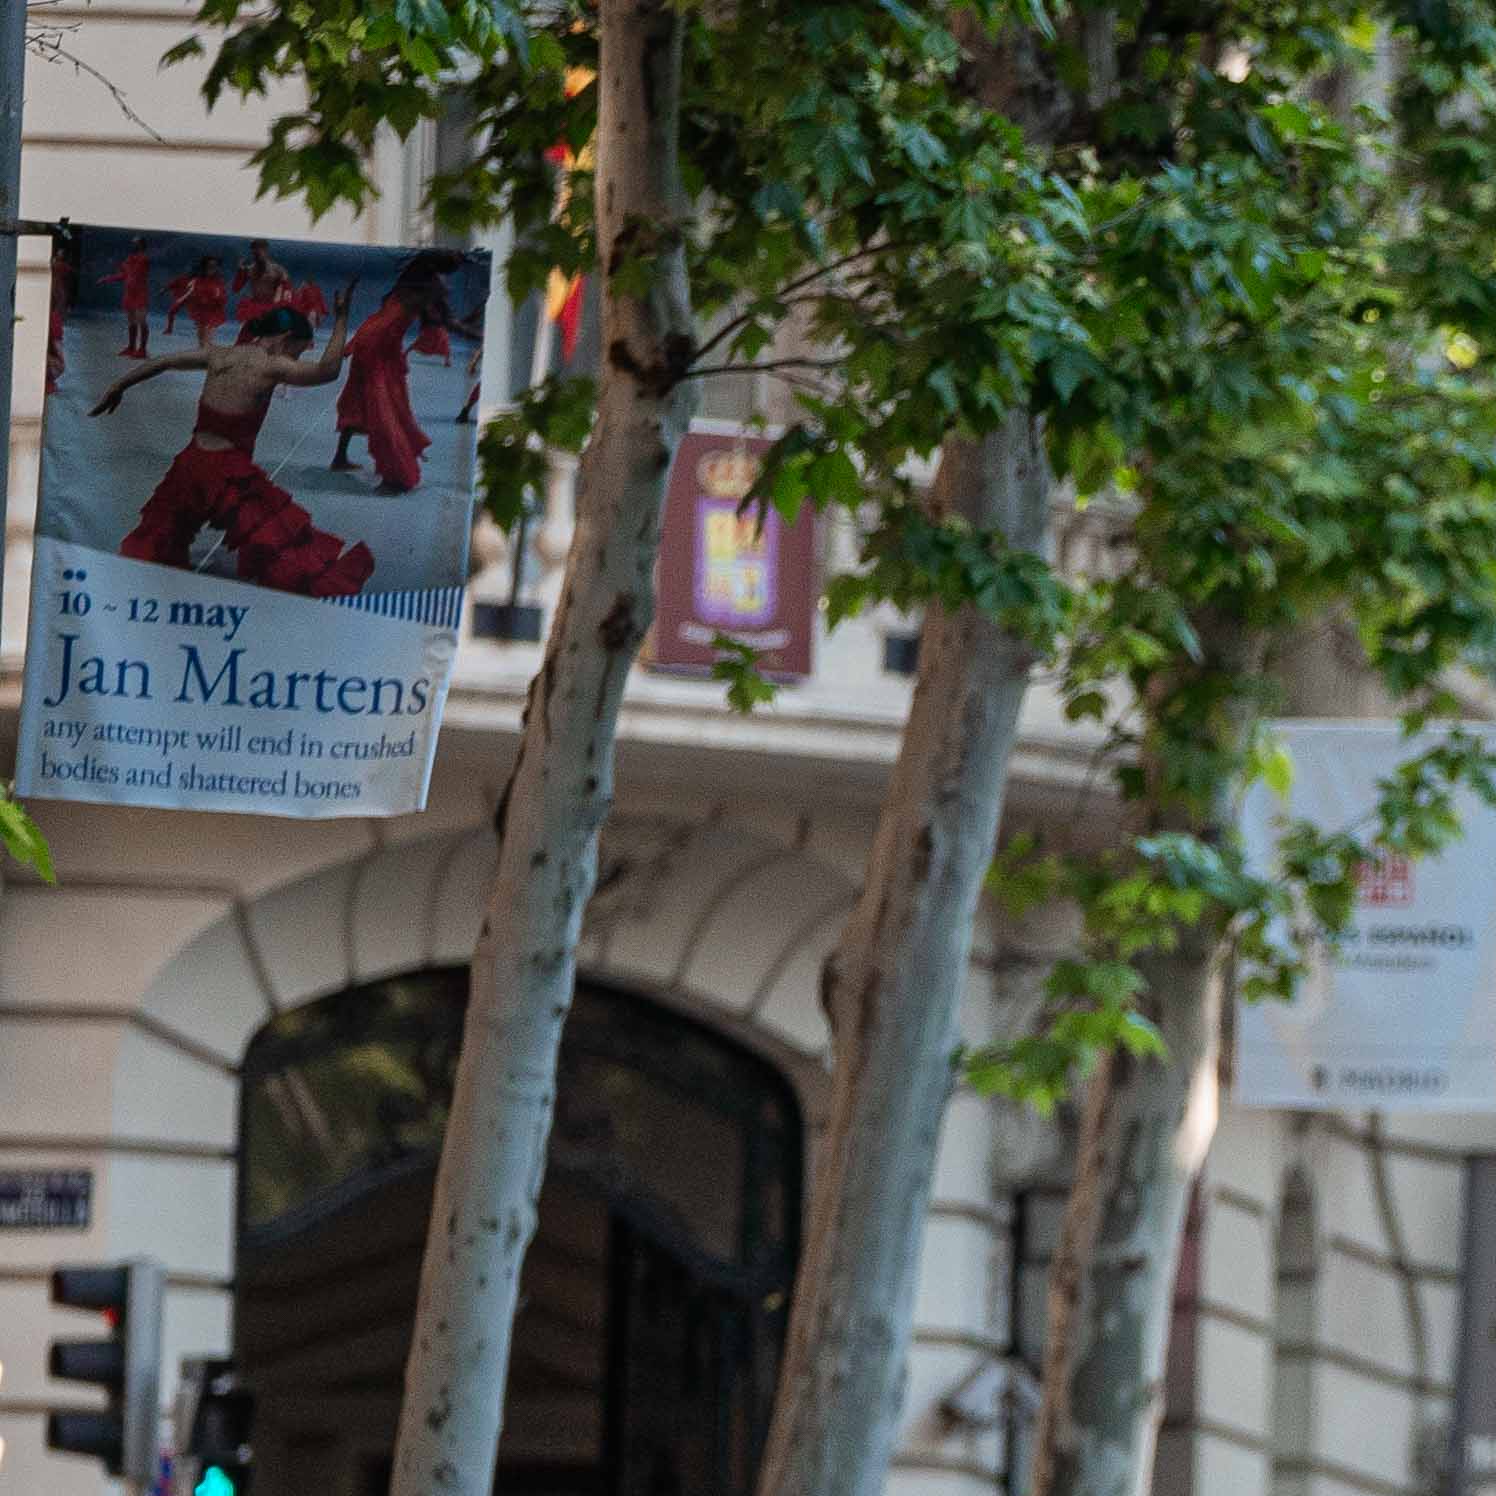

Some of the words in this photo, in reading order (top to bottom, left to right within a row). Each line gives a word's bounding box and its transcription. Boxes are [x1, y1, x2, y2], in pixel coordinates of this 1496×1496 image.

[57, 591, 91, 616] 10
[128, 597, 160, 623] 12
[169, 600, 249, 642] may
[43, 633, 152, 708] Jan
[173, 644, 430, 716] Martens
[44, 719, 88, 748] any
[93, 721, 190, 756] attempt
[197, 725, 242, 753] will
[248, 728, 293, 756] end
[300, 732, 323, 758] in
[329, 730, 416, 760] crushed
[40, 751, 120, 784] bodies
[125, 762, 173, 787] and
[179, 763, 287, 796] shattered
[294, 770, 361, 799] bones
